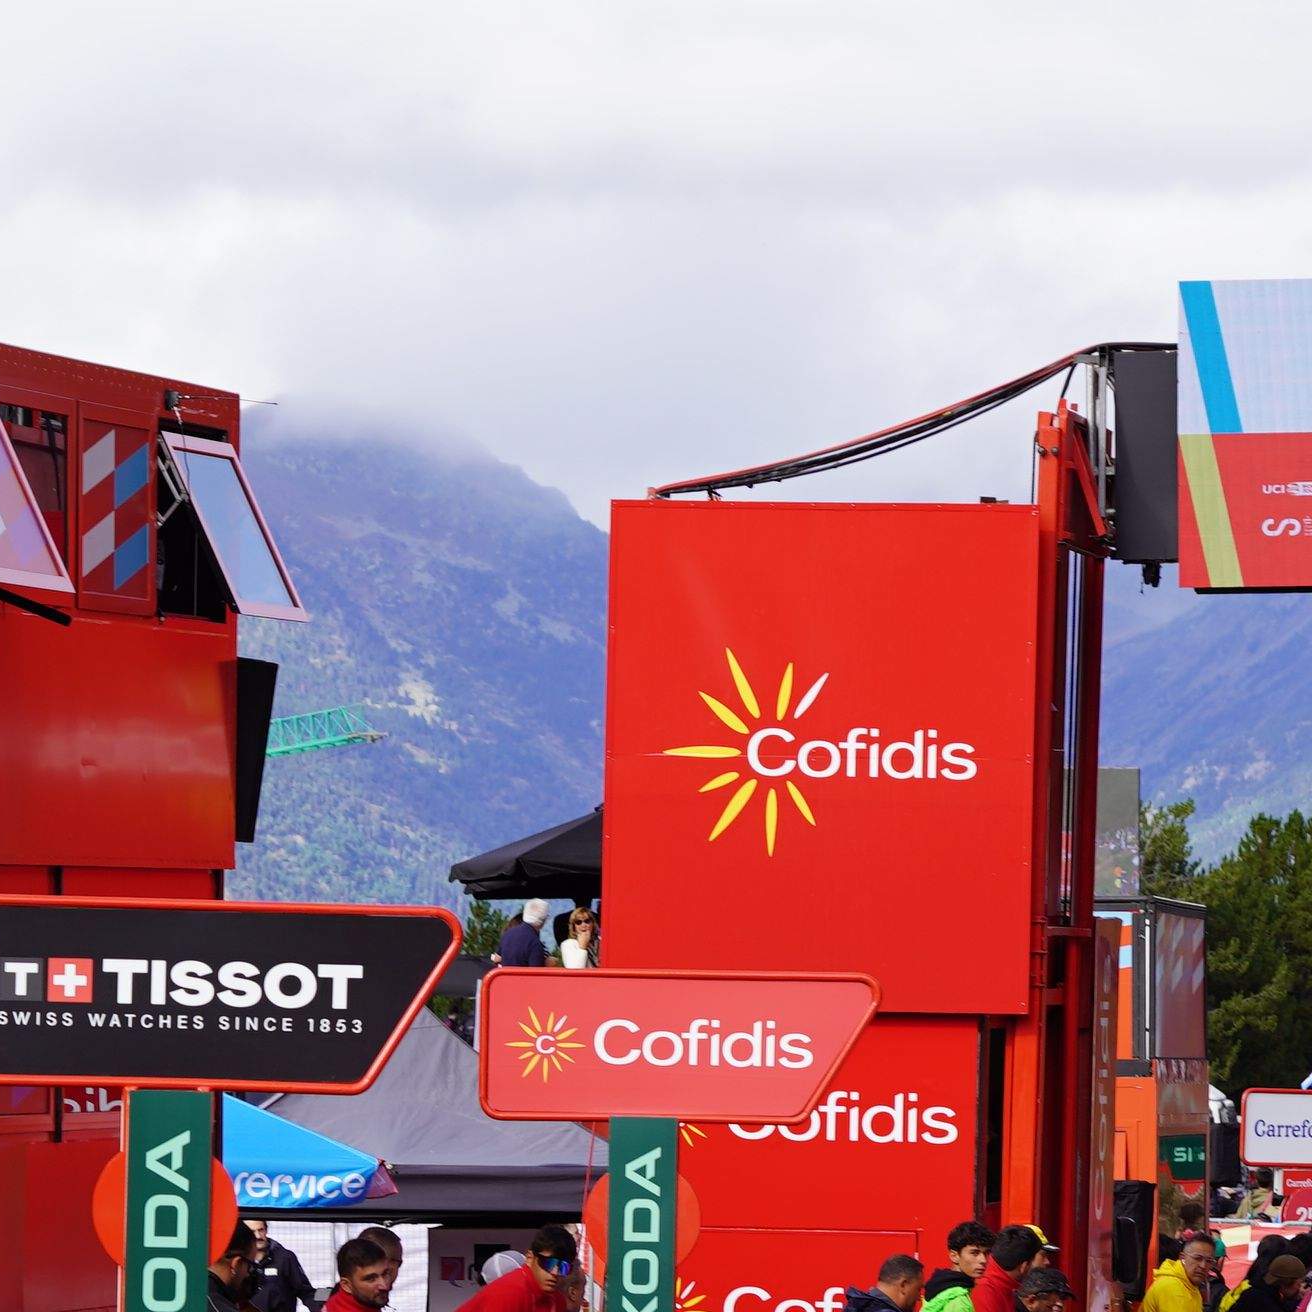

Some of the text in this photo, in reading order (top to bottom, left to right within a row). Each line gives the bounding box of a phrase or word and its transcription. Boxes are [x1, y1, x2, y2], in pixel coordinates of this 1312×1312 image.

[746, 727, 978, 782] Cofidis
[101, 957, 364, 1010] TISSOT
[88, 1012, 205, 1031] WATCHES
[217, 1015, 294, 1032] SINCE
[307, 1018, 363, 1034] 1853
[592, 1019, 814, 1069] Cofidis
